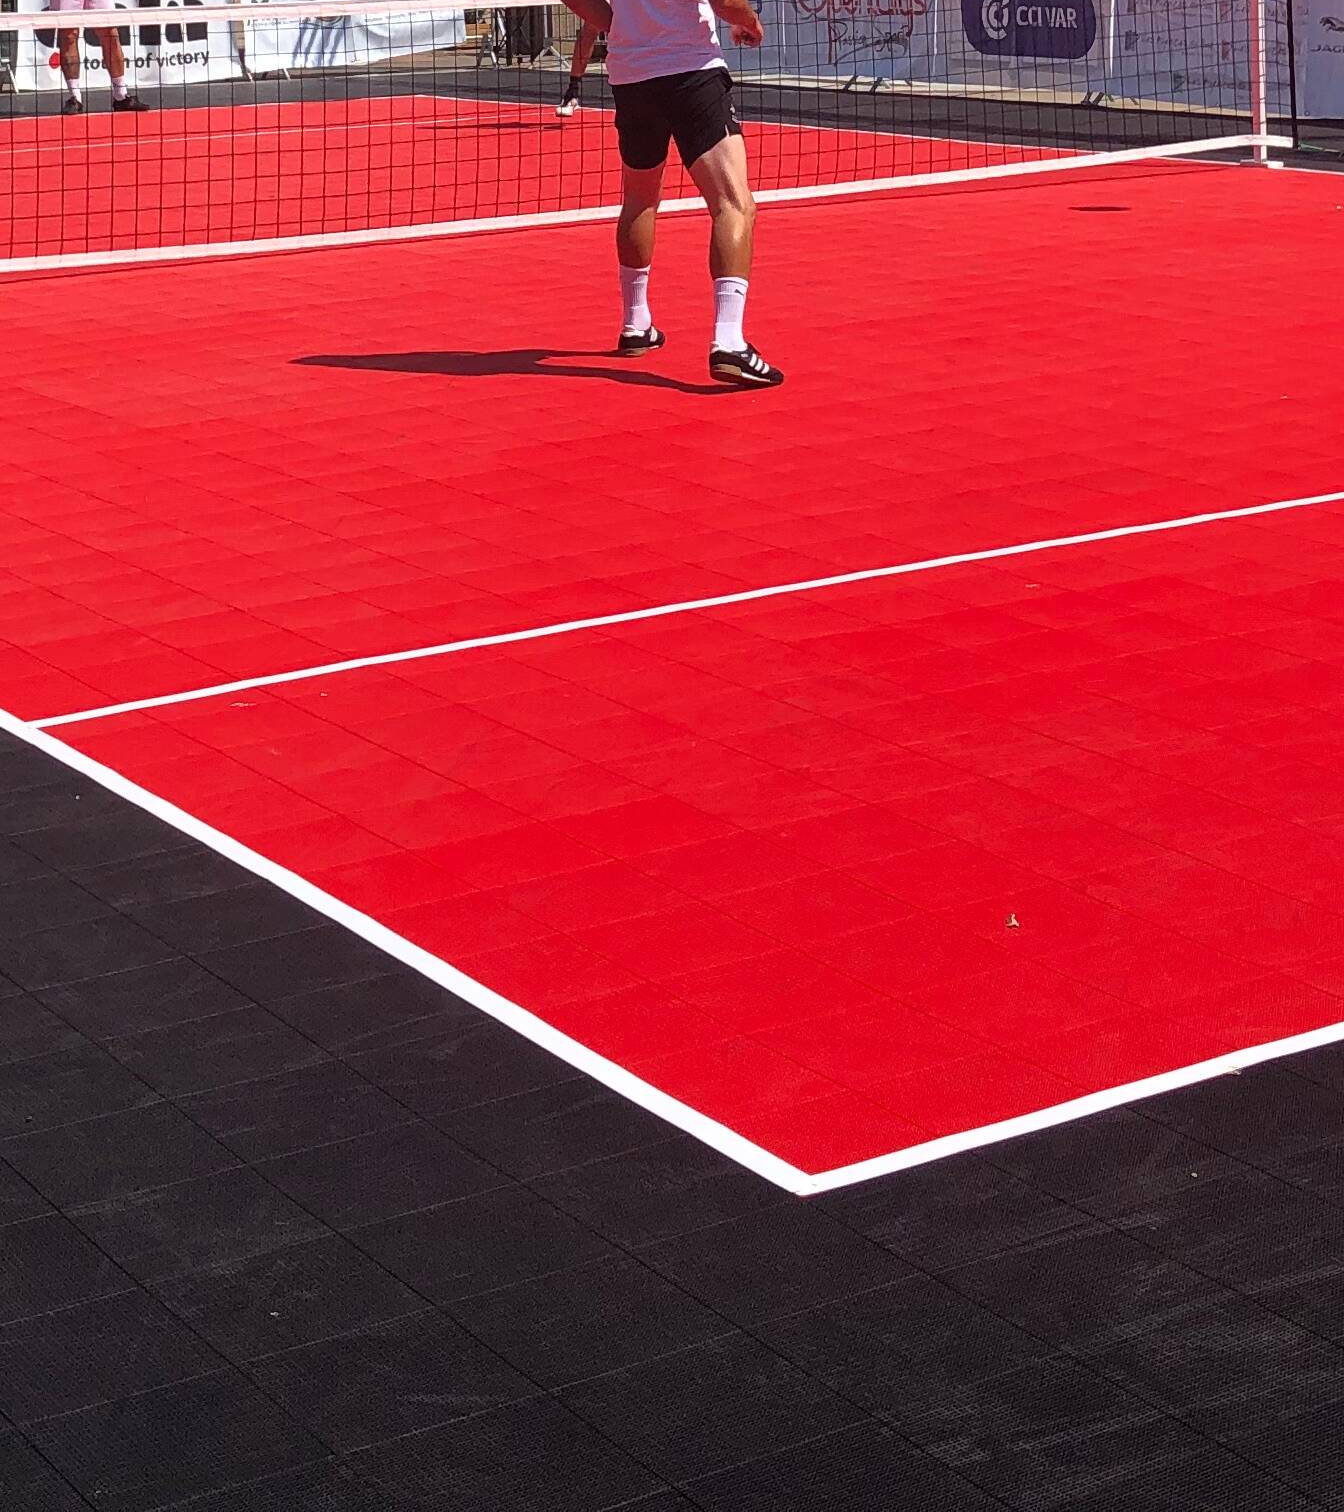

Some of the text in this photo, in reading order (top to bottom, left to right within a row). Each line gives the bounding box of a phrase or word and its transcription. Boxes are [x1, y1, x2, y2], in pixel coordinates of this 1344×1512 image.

[1044, 6, 1078, 29] VAR
[135, 52, 155, 69] of
[157, 50, 210, 69] victory
